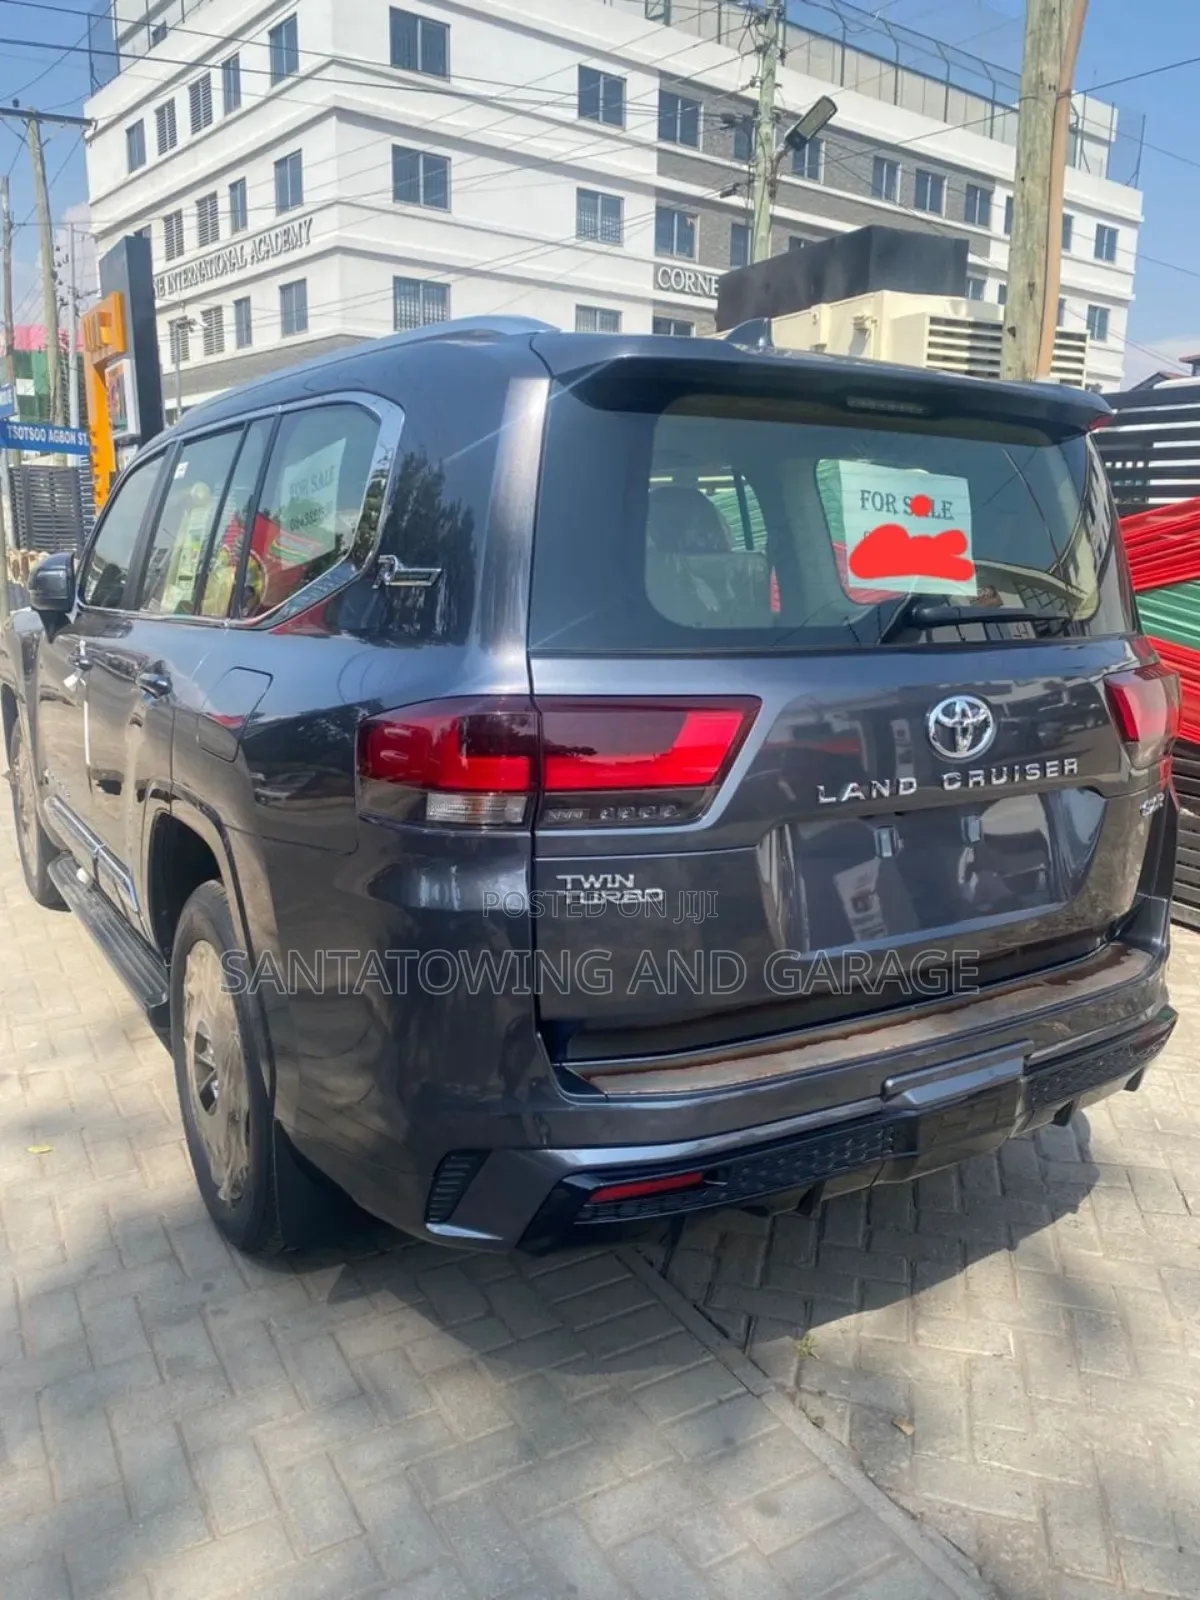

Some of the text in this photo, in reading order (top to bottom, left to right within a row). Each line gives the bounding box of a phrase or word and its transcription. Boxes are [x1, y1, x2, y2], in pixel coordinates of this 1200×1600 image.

[168, 245, 248, 295] INTERNATIONAL
[250, 216, 314, 266] ACADEMY
[860, 489, 955, 521] FOR SLE
[818, 757, 1079, 804] LAND CRUISER
[556, 874, 635, 889] TWIN
[556, 888, 664, 904] TURBO
